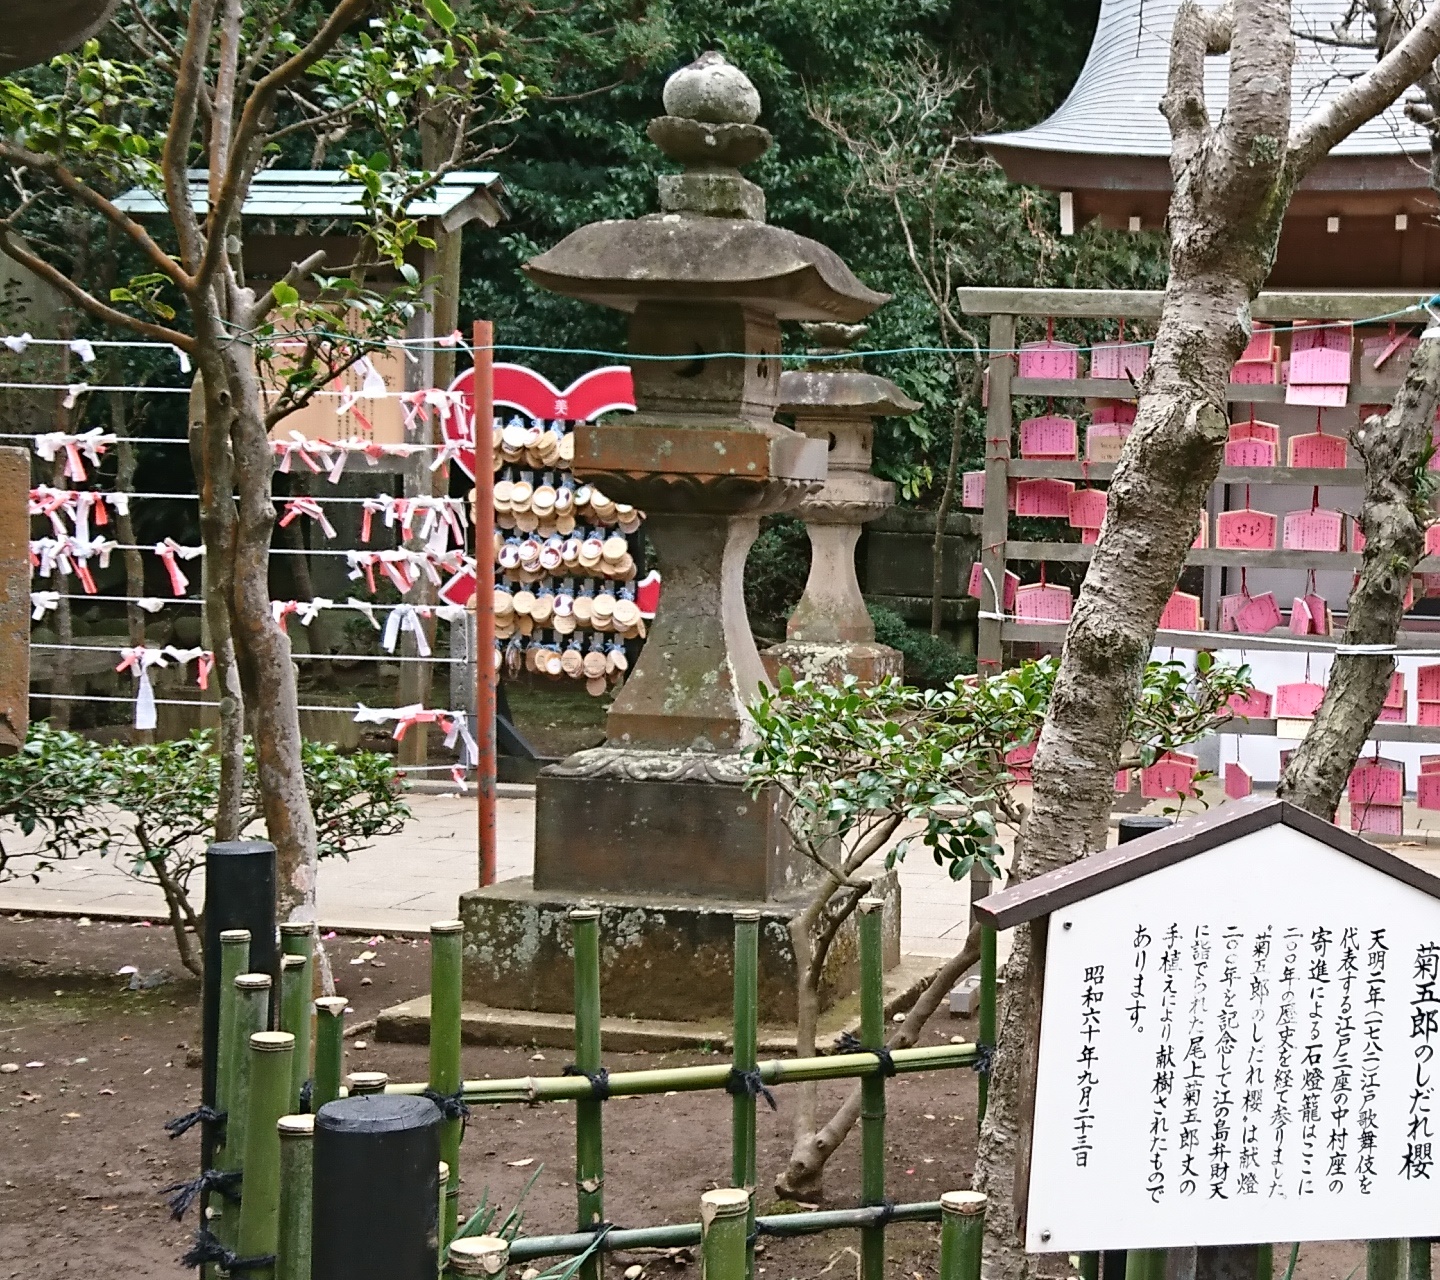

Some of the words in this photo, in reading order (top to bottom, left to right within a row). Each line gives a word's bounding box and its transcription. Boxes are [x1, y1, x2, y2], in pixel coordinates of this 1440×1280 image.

[554, 399, 568, 415] 美
[1071, 964, 1105, 1168] 昭和六十年九月二十三日
[1124, 923, 1152, 1033] あります。
[1145, 922, 1184, 1204] 手植えにより献樹されたもので
[1178, 924, 1212, 1197] に詣でられた尾上菊五郎丈の
[1297, 925, 1333, 1196] 寄進による石燈籠はここに
[1325, 926, 1360, 1195] 代表する江戸三座の中村座の
